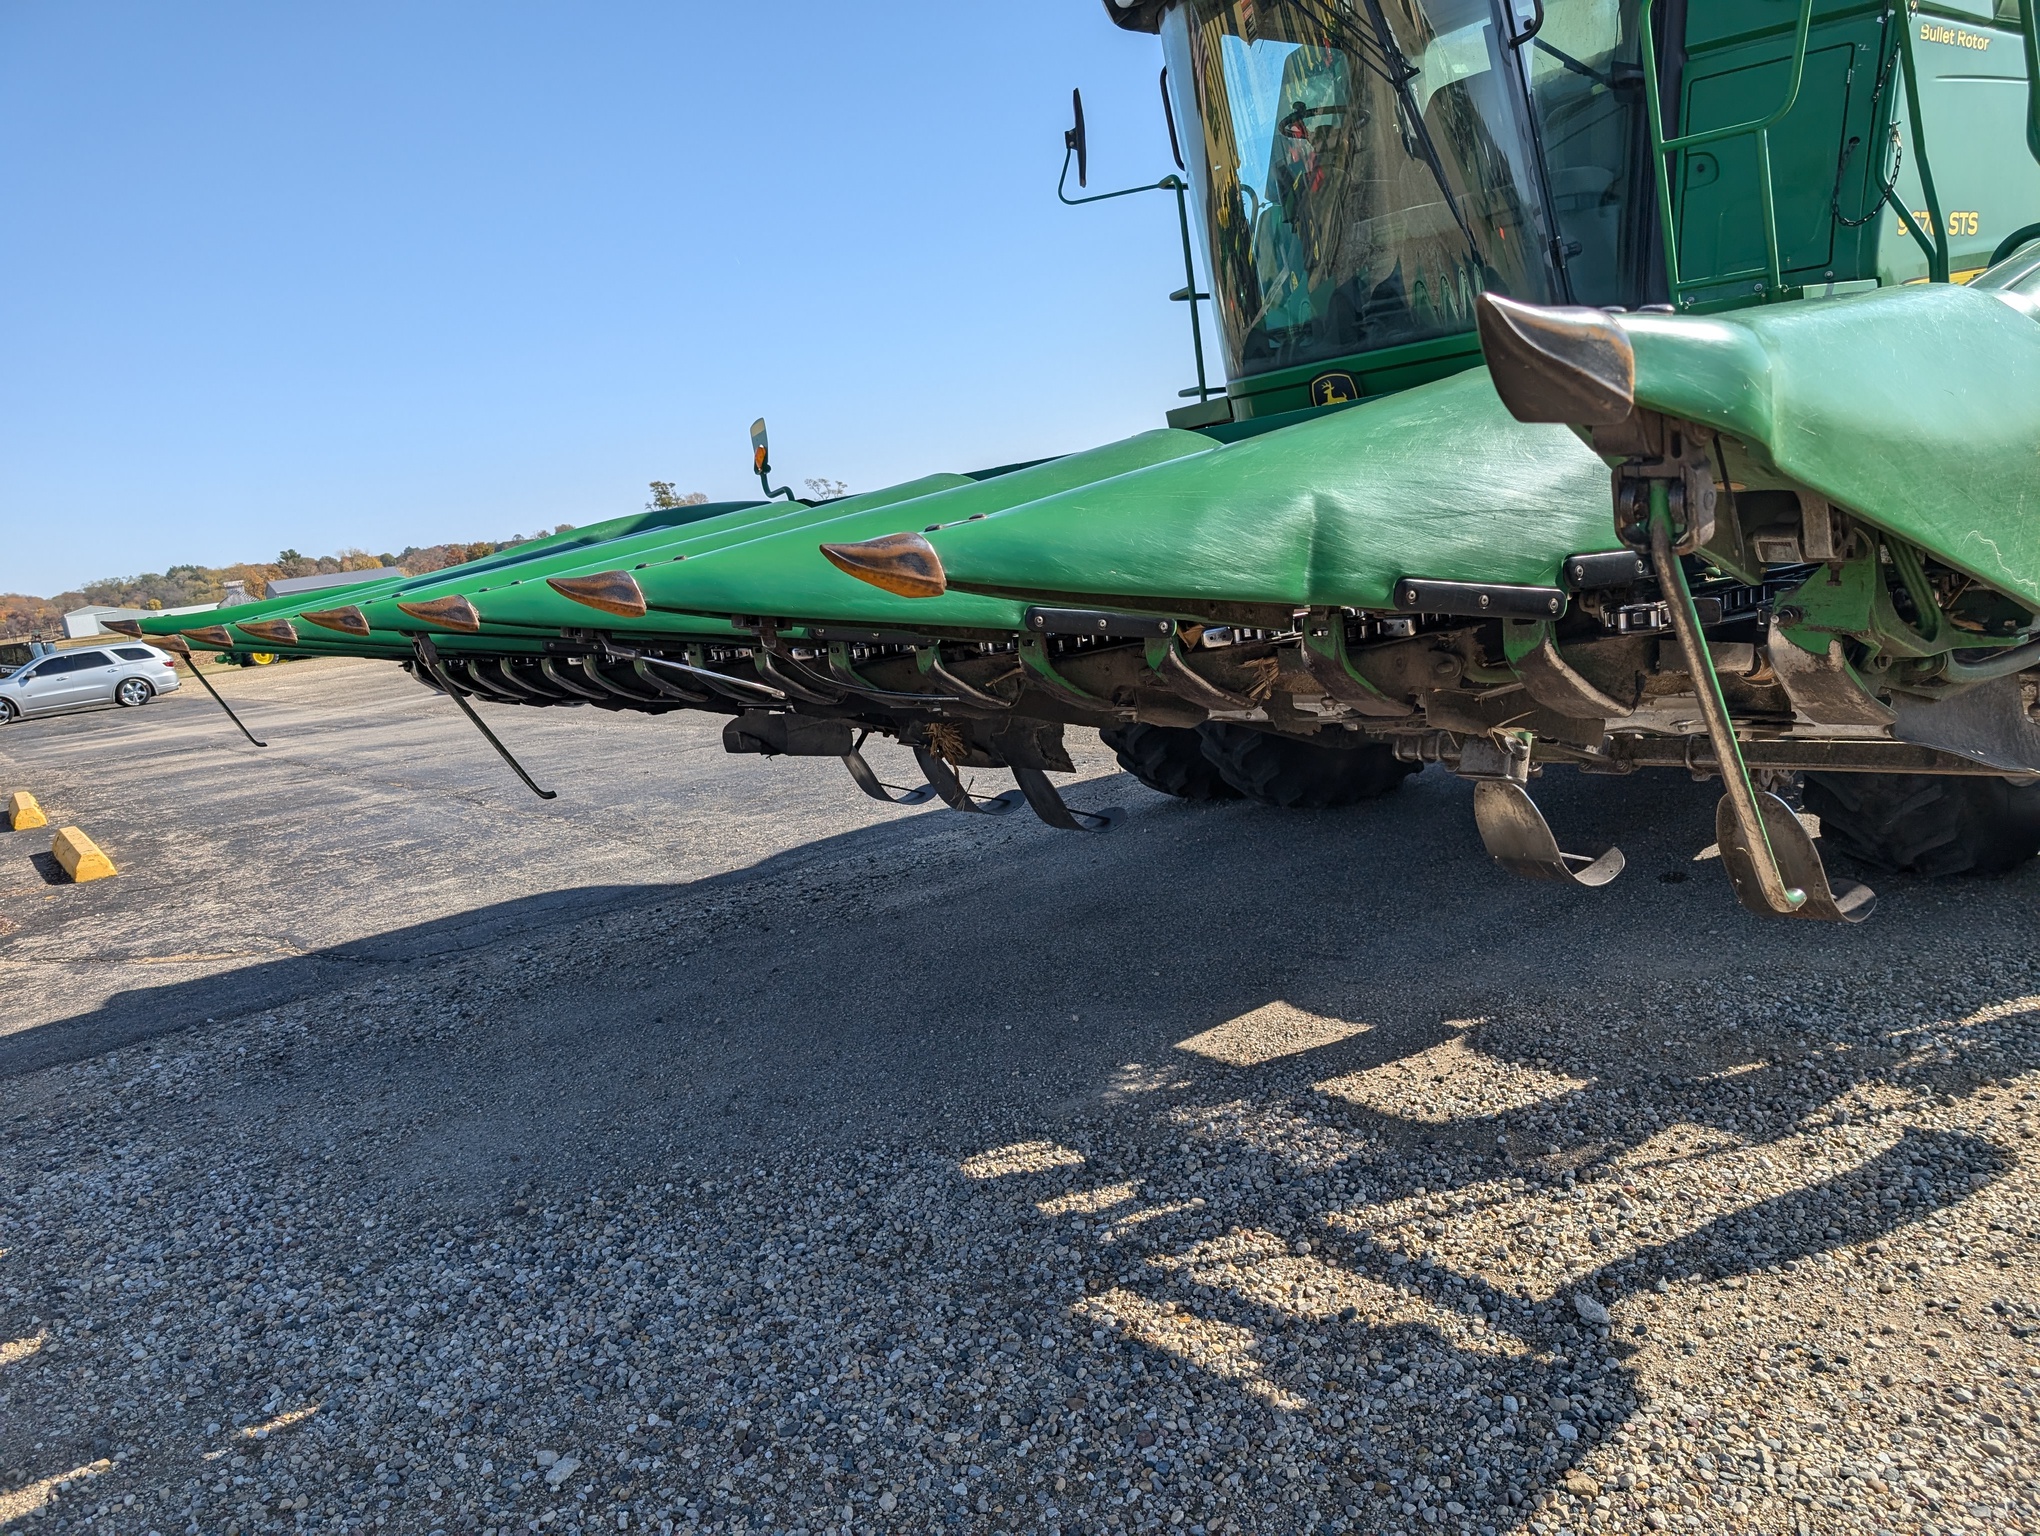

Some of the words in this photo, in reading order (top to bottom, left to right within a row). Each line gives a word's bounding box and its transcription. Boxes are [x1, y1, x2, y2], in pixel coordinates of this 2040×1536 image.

[1920, 23, 1955, 45] Bullet
[1957, 29, 1991, 52] Rotor
[1948, 210, 1979, 236] STS
